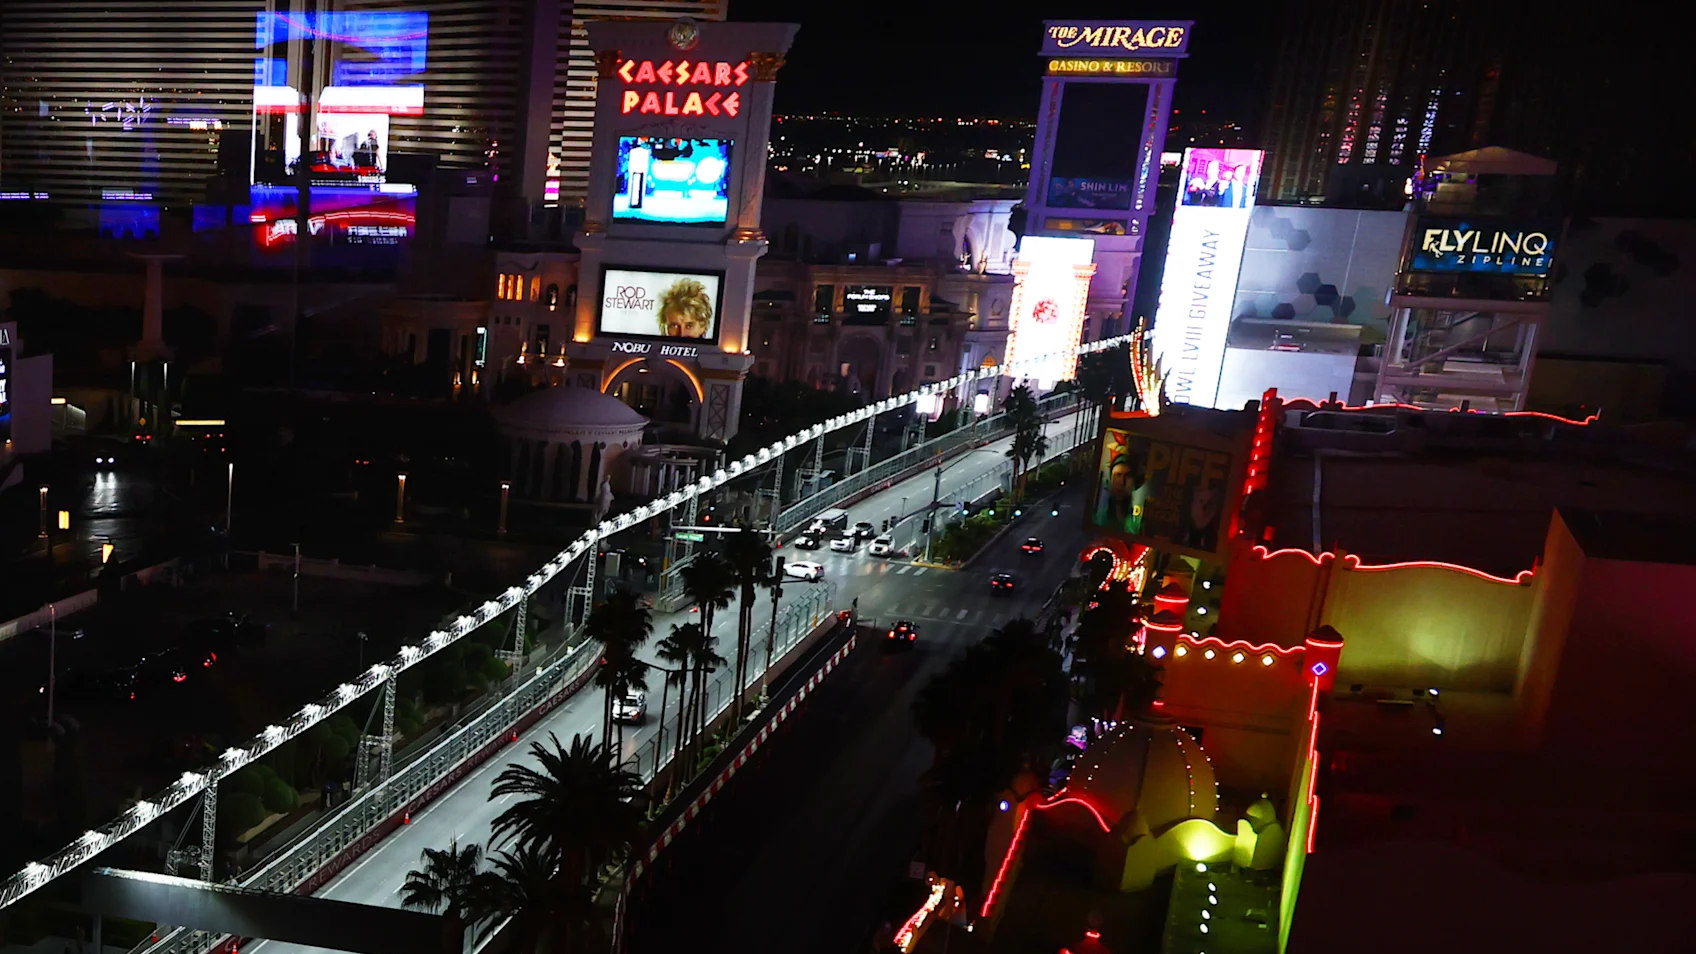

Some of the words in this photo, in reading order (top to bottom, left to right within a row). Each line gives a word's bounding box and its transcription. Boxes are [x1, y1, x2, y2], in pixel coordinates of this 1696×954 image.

[1058, 26, 1185, 50] MIRAGE
[618, 59, 750, 87] CAESARS
[1048, 60, 1100, 72] CASINO
[1103, 61, 1112, 72] &
[1116, 61, 1173, 73] RESORT
[622, 90, 741, 117] PALACE
[1422, 229, 1548, 256] FLYLINQ
[1189, 229, 1220, 319] GIVEAWAY
[1456, 254, 1544, 267] ZIPLINE
[605, 297, 655, 310] STEWART
[616, 286, 646, 299] ROD
[612, 341, 651, 354] NOBU
[660, 345, 699, 357] HOTEL
[1181, 326, 1203, 361] LVIII
[1145, 441, 1230, 490] PIFF
[407, 768, 463, 814] CAESARS
[308, 829, 381, 890] REWARDS
